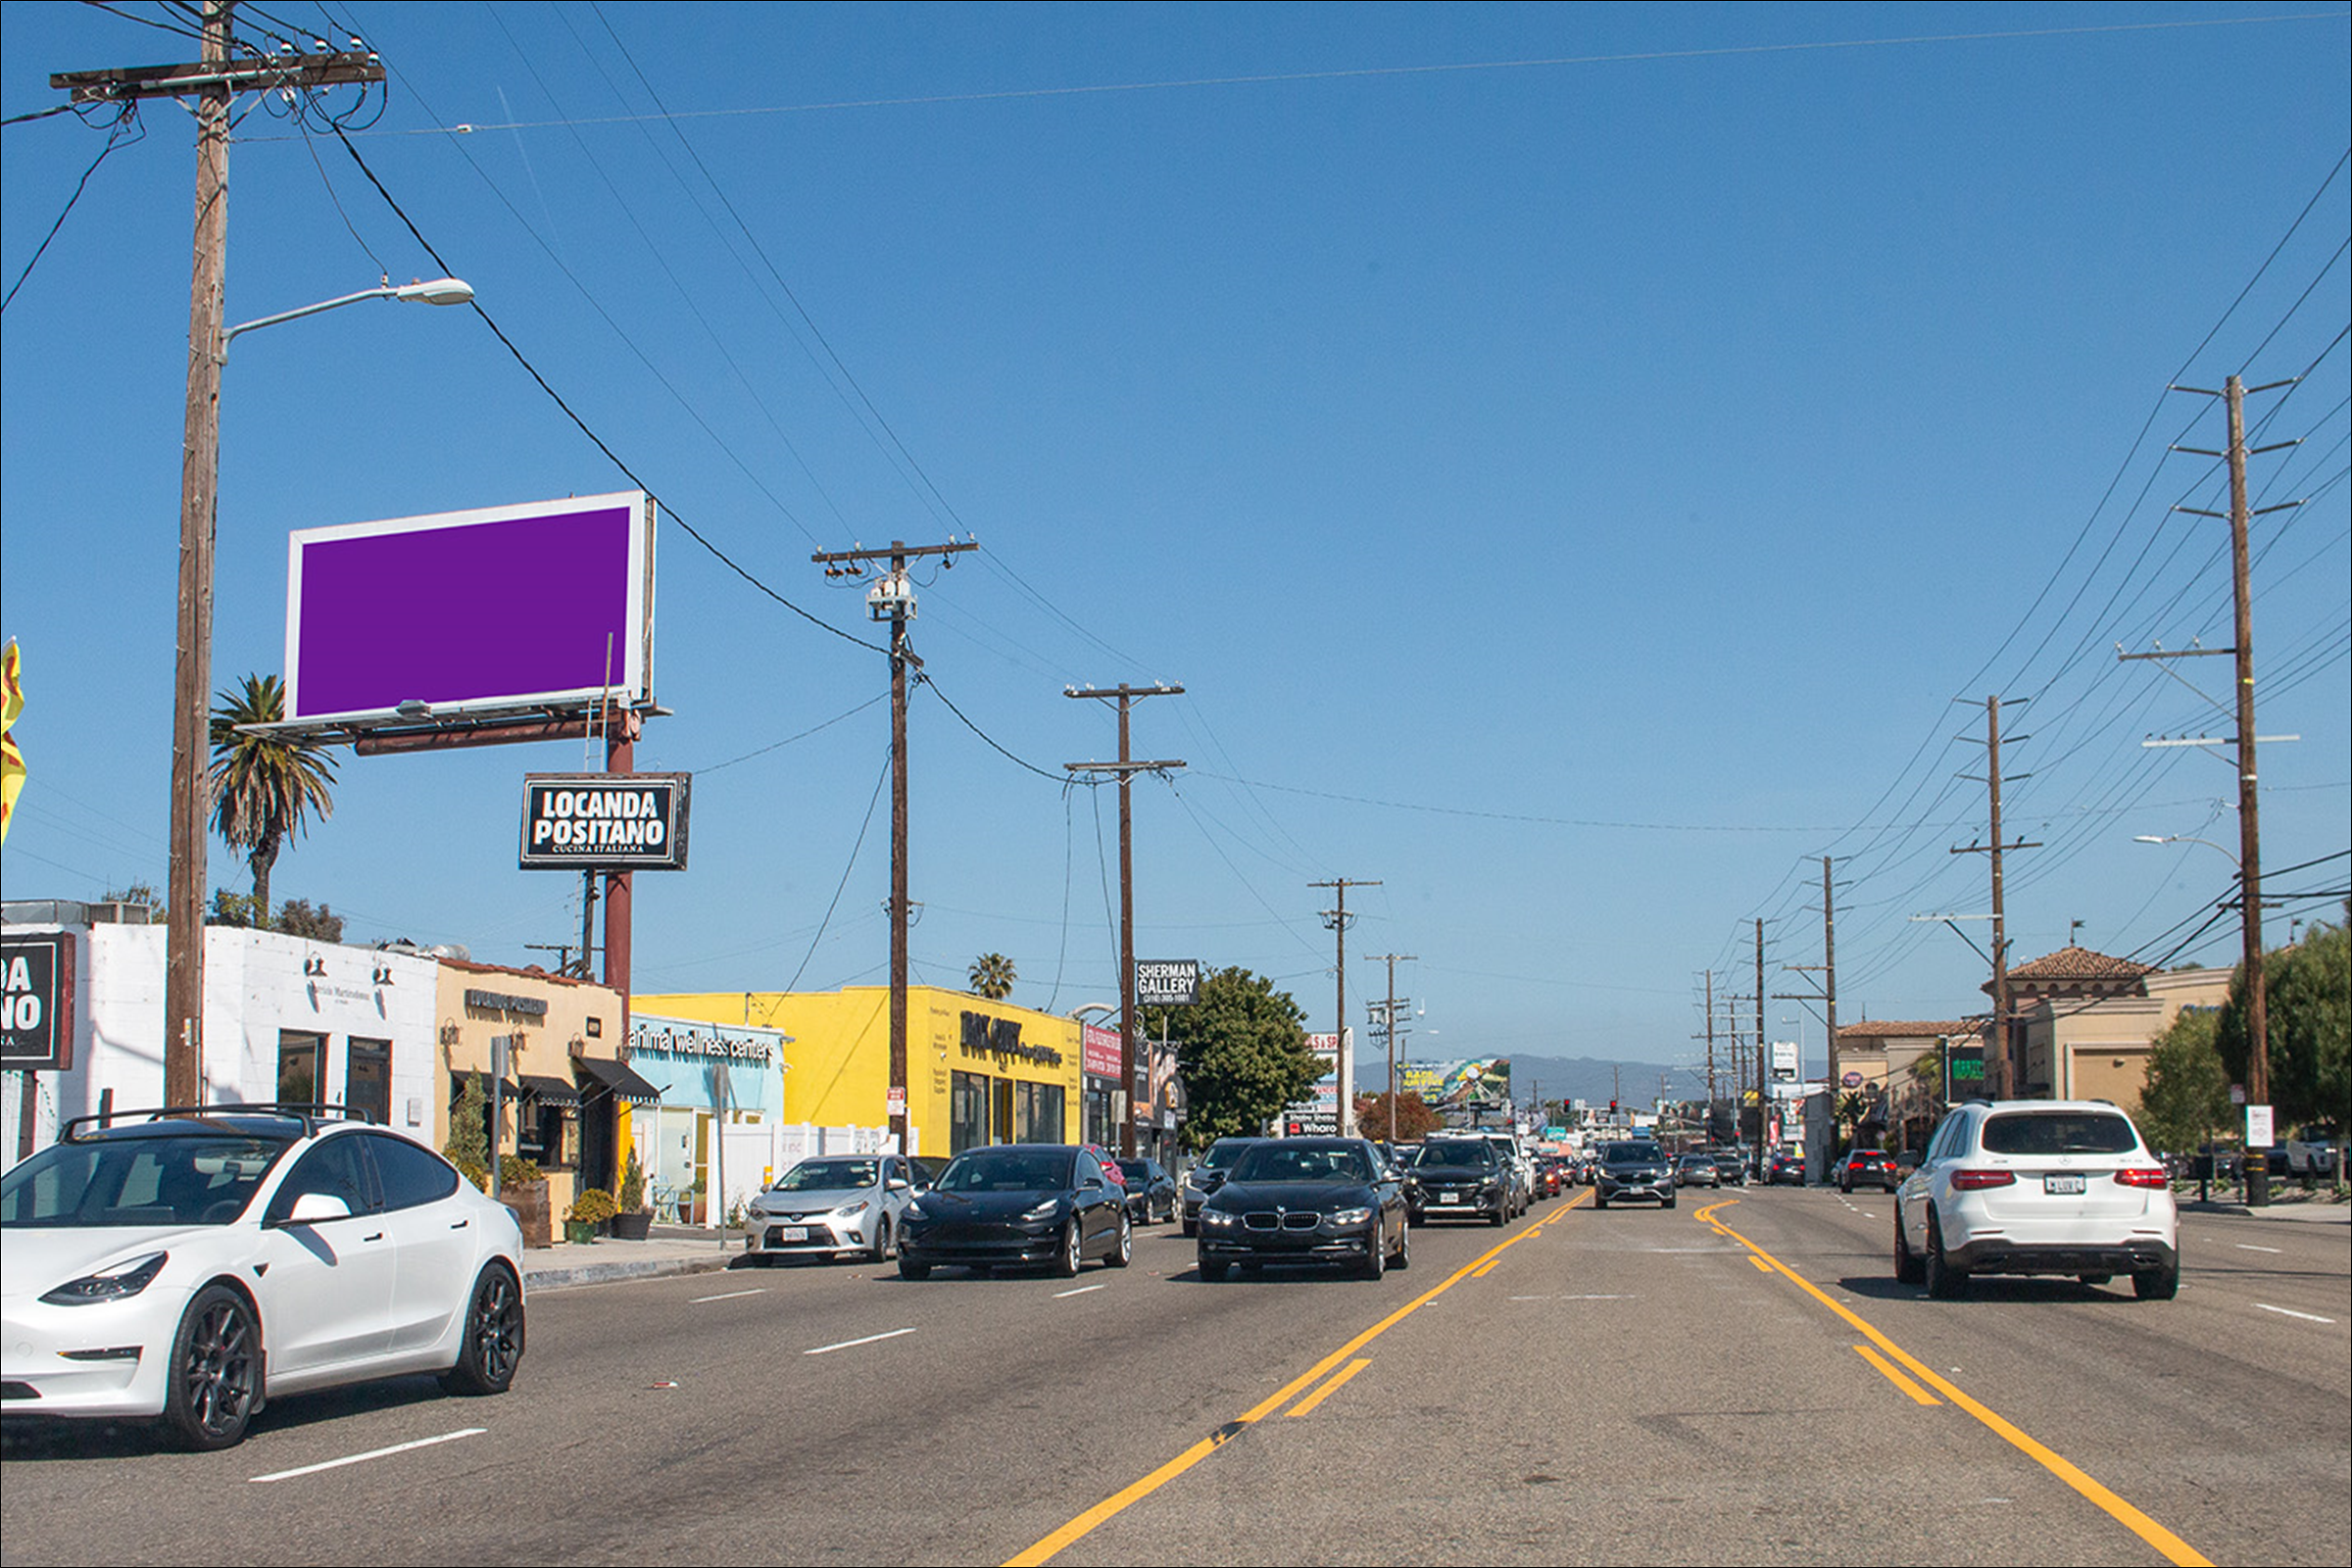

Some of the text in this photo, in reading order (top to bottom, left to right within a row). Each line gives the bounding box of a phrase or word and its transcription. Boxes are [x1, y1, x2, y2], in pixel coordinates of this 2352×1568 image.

[542, 791, 658, 818] LOCANDA
[534, 819, 664, 845] POSITANO
[552, 845, 592, 854] CUCINA
[1138, 963, 1196, 978] SHERMAN
[1138, 978, 1195, 994] GALLERY
[628, 1024, 774, 1059] animal wellness centers
